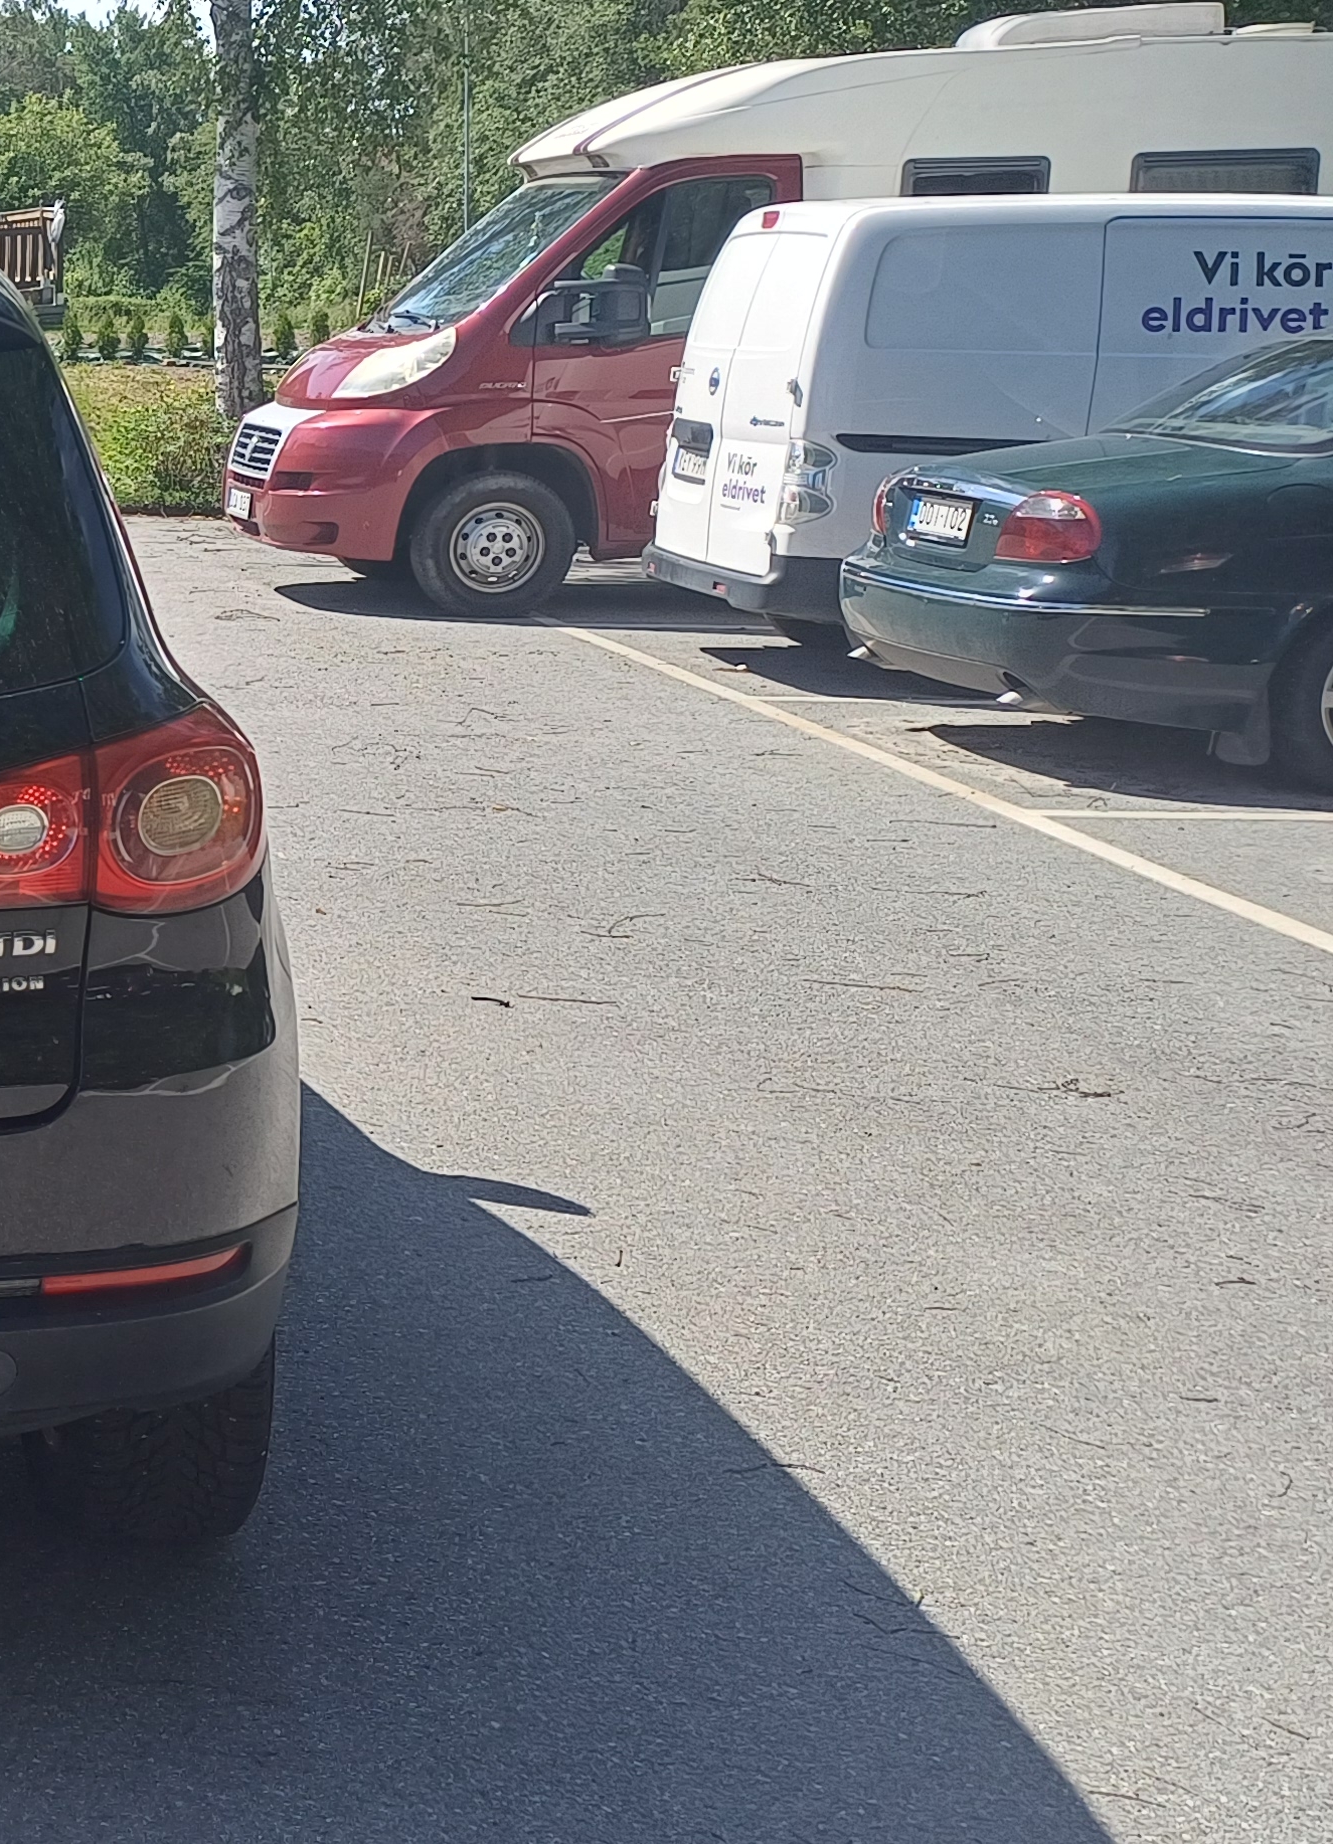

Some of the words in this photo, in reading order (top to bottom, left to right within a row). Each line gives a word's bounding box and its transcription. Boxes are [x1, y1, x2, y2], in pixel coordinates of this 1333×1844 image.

[1193, 251, 1240, 287] Vi
[1141, 297, 1329, 334] eldrivet
[727, 452, 738, 474] Vi
[722, 478, 766, 504] eldrivet
